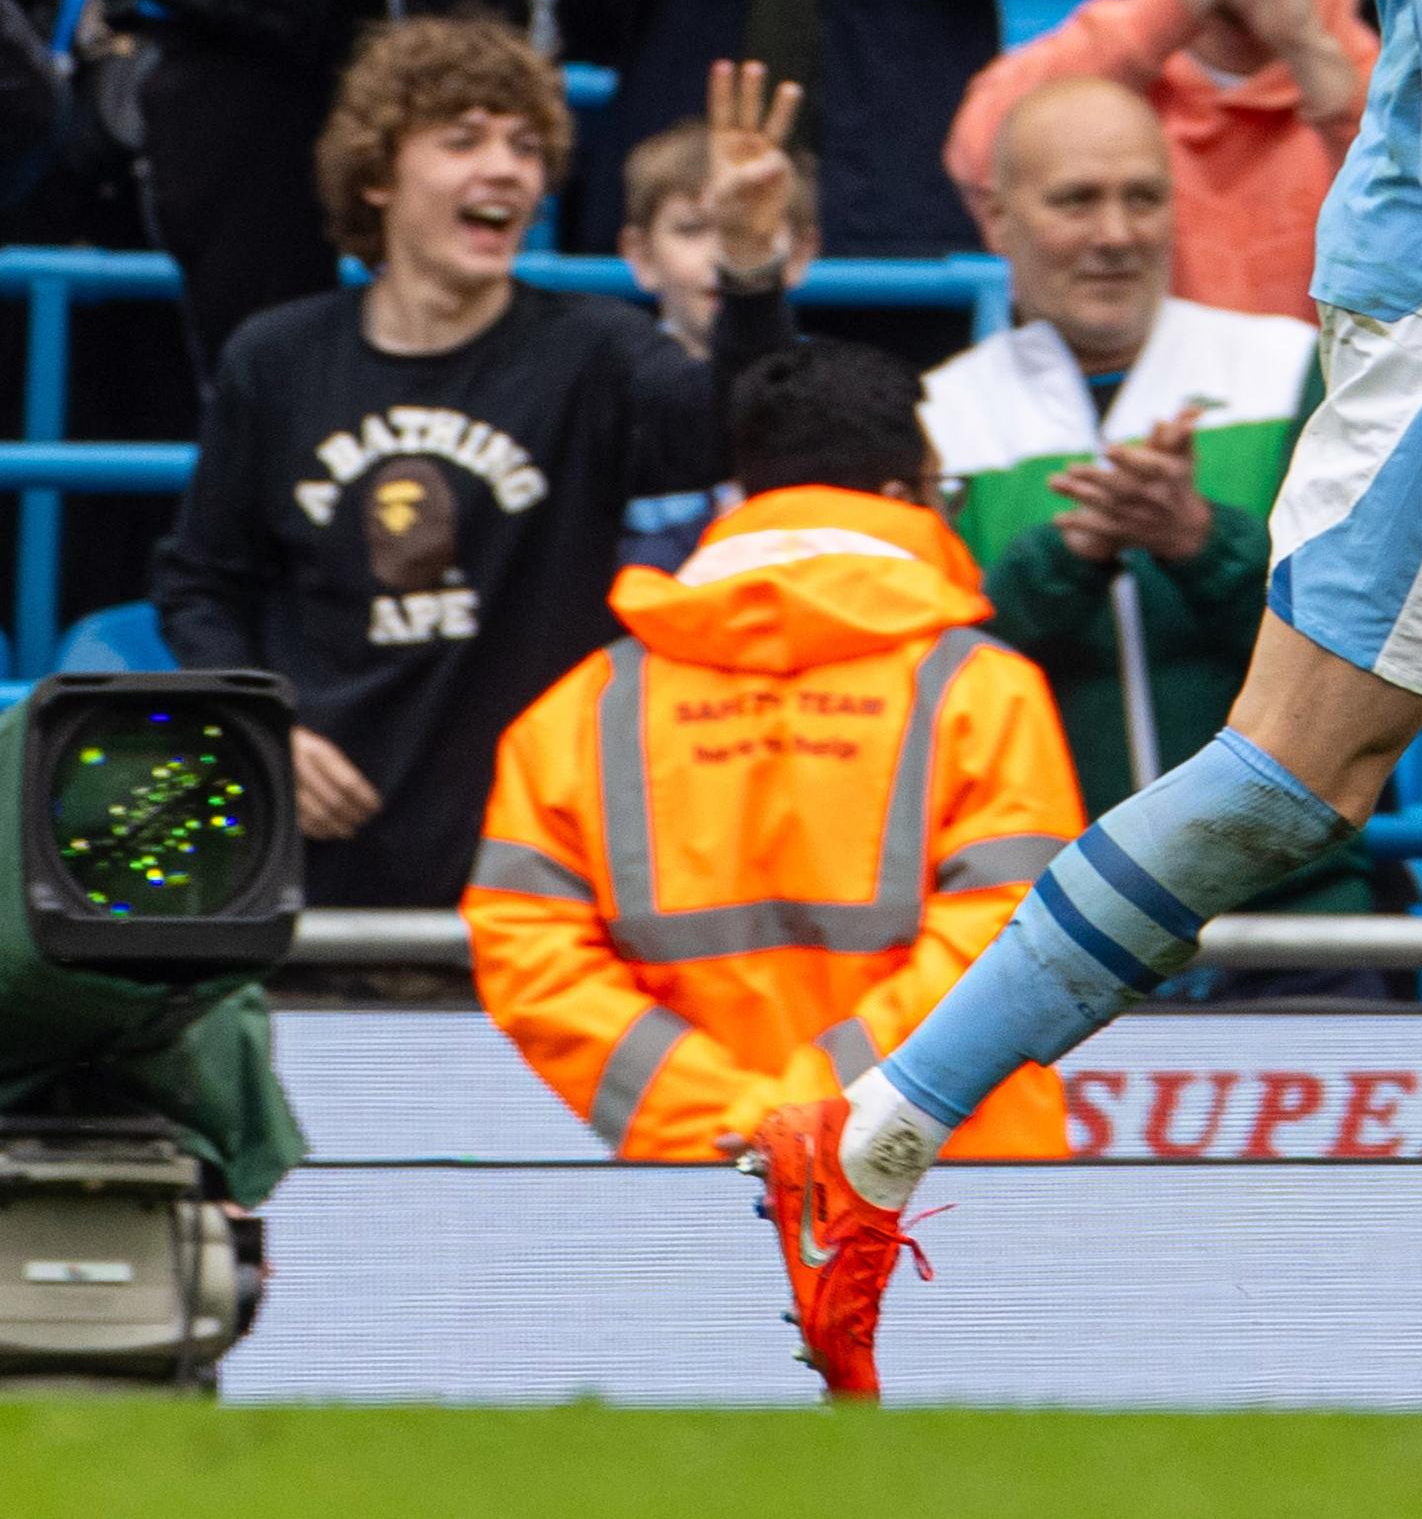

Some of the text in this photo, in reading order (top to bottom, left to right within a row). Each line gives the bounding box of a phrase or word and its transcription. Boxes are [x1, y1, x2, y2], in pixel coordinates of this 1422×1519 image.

[294, 405, 548, 528] A BATHING
[367, 588, 480, 646] APE
[799, 690, 888, 717] TEAM
